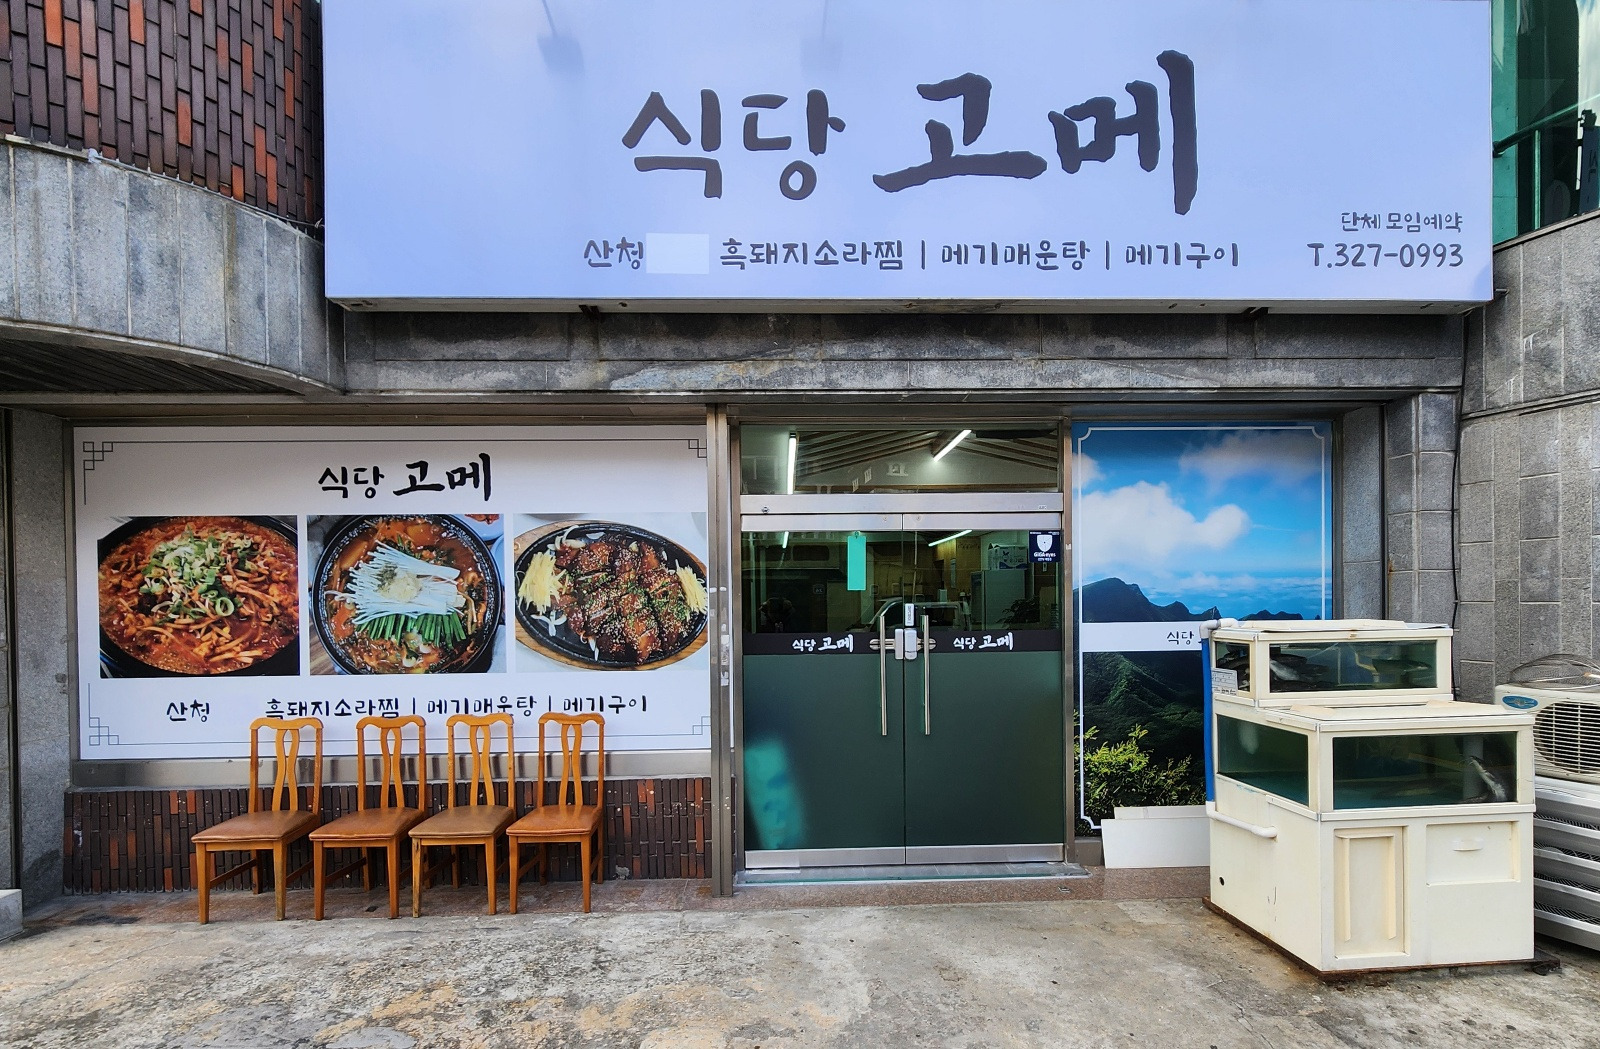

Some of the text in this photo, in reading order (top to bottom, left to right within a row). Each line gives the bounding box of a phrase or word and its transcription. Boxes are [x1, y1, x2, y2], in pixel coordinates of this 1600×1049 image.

[622, 50, 1198, 215] 식당 고메
[1342, 212, 1380, 231] 단체
[584, 237, 1239, 271] 산청 흑돼지소라찜 메기매운탕 메기구이
[1307, 243, 1463, 269] T.327-0993
[318, 452, 491, 502] 식당 고메
[792, 634, 854, 653] 식당 고메
[953, 632, 1014, 651] 식당 고메
[1167, 631, 1194, 645] 식당
[167, 699, 214, 723] 산청
[265, 698, 400, 719] 흑돼지소라찜
[563, 695, 647, 714] 메기구이
